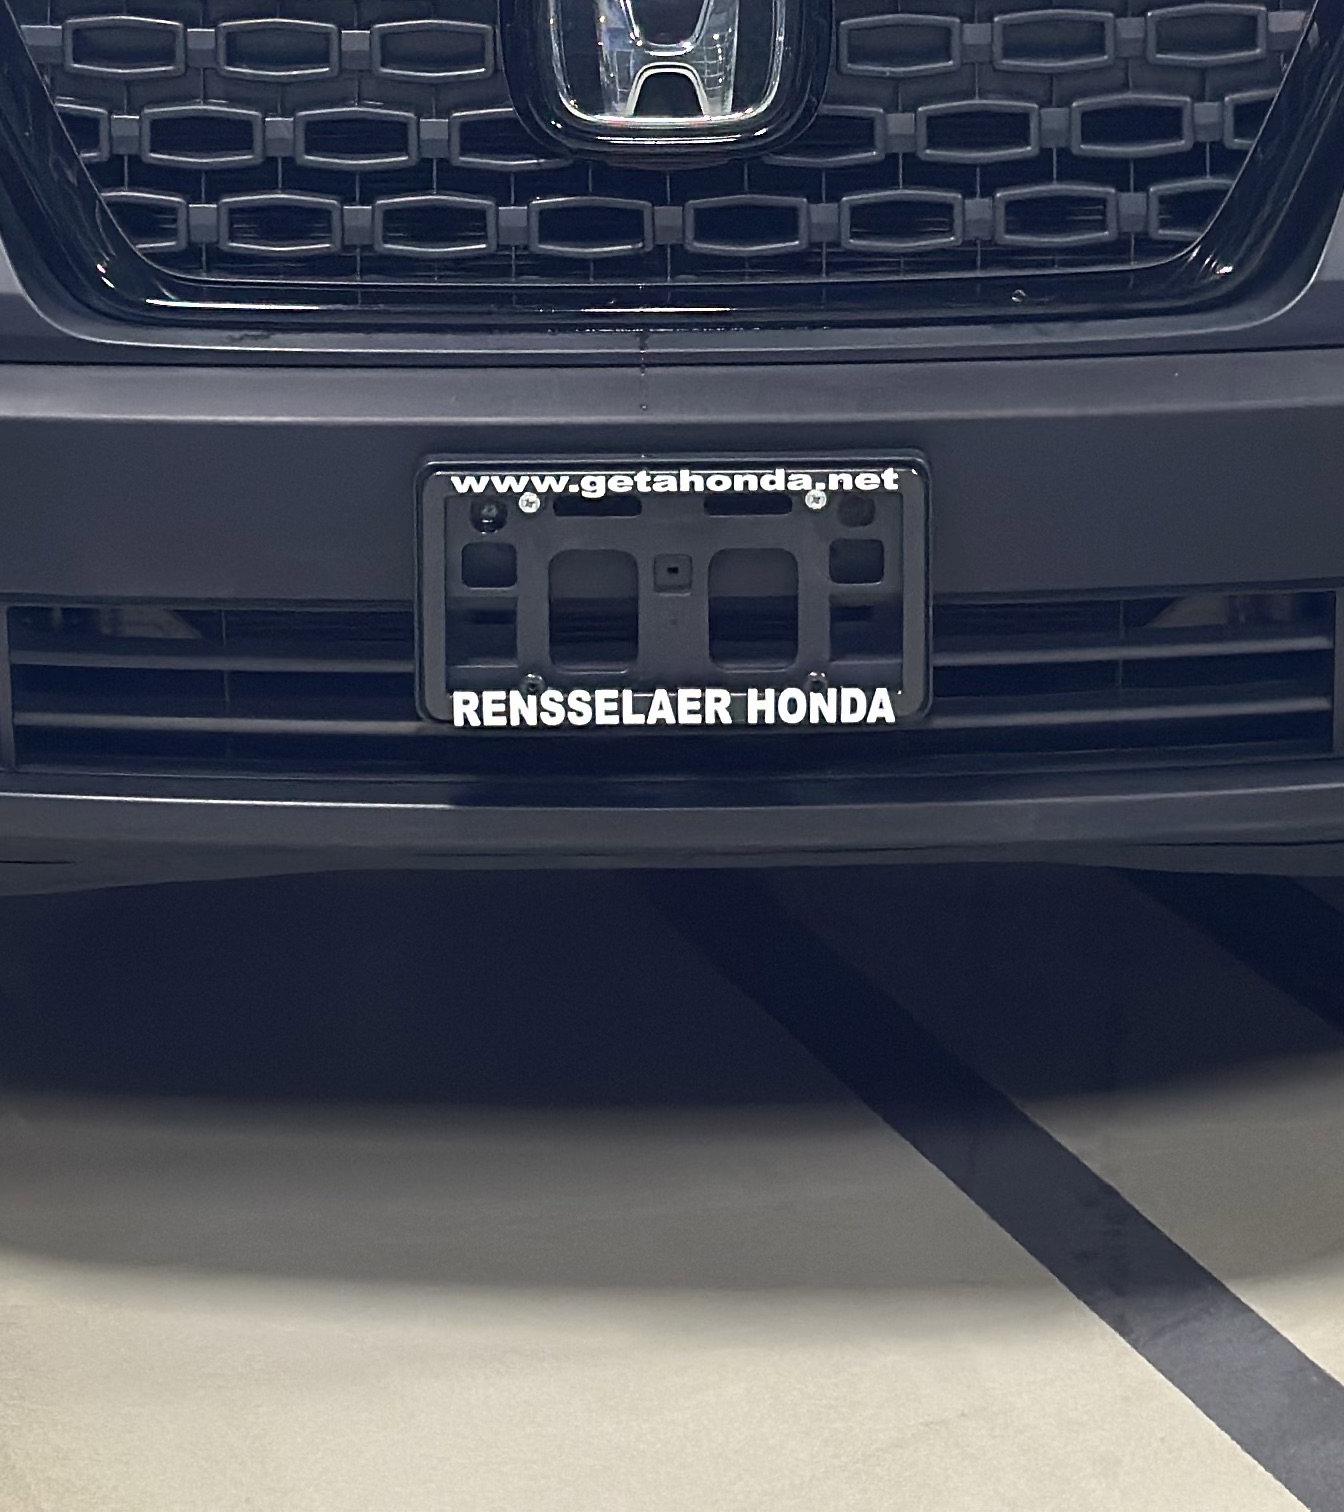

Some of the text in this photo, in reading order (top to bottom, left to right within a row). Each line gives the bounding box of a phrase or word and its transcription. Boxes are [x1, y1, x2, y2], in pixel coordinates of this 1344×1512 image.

[451, 468, 899, 498] www.getahonda.net
[452, 688, 896, 727] RENSSELAER HONDA
